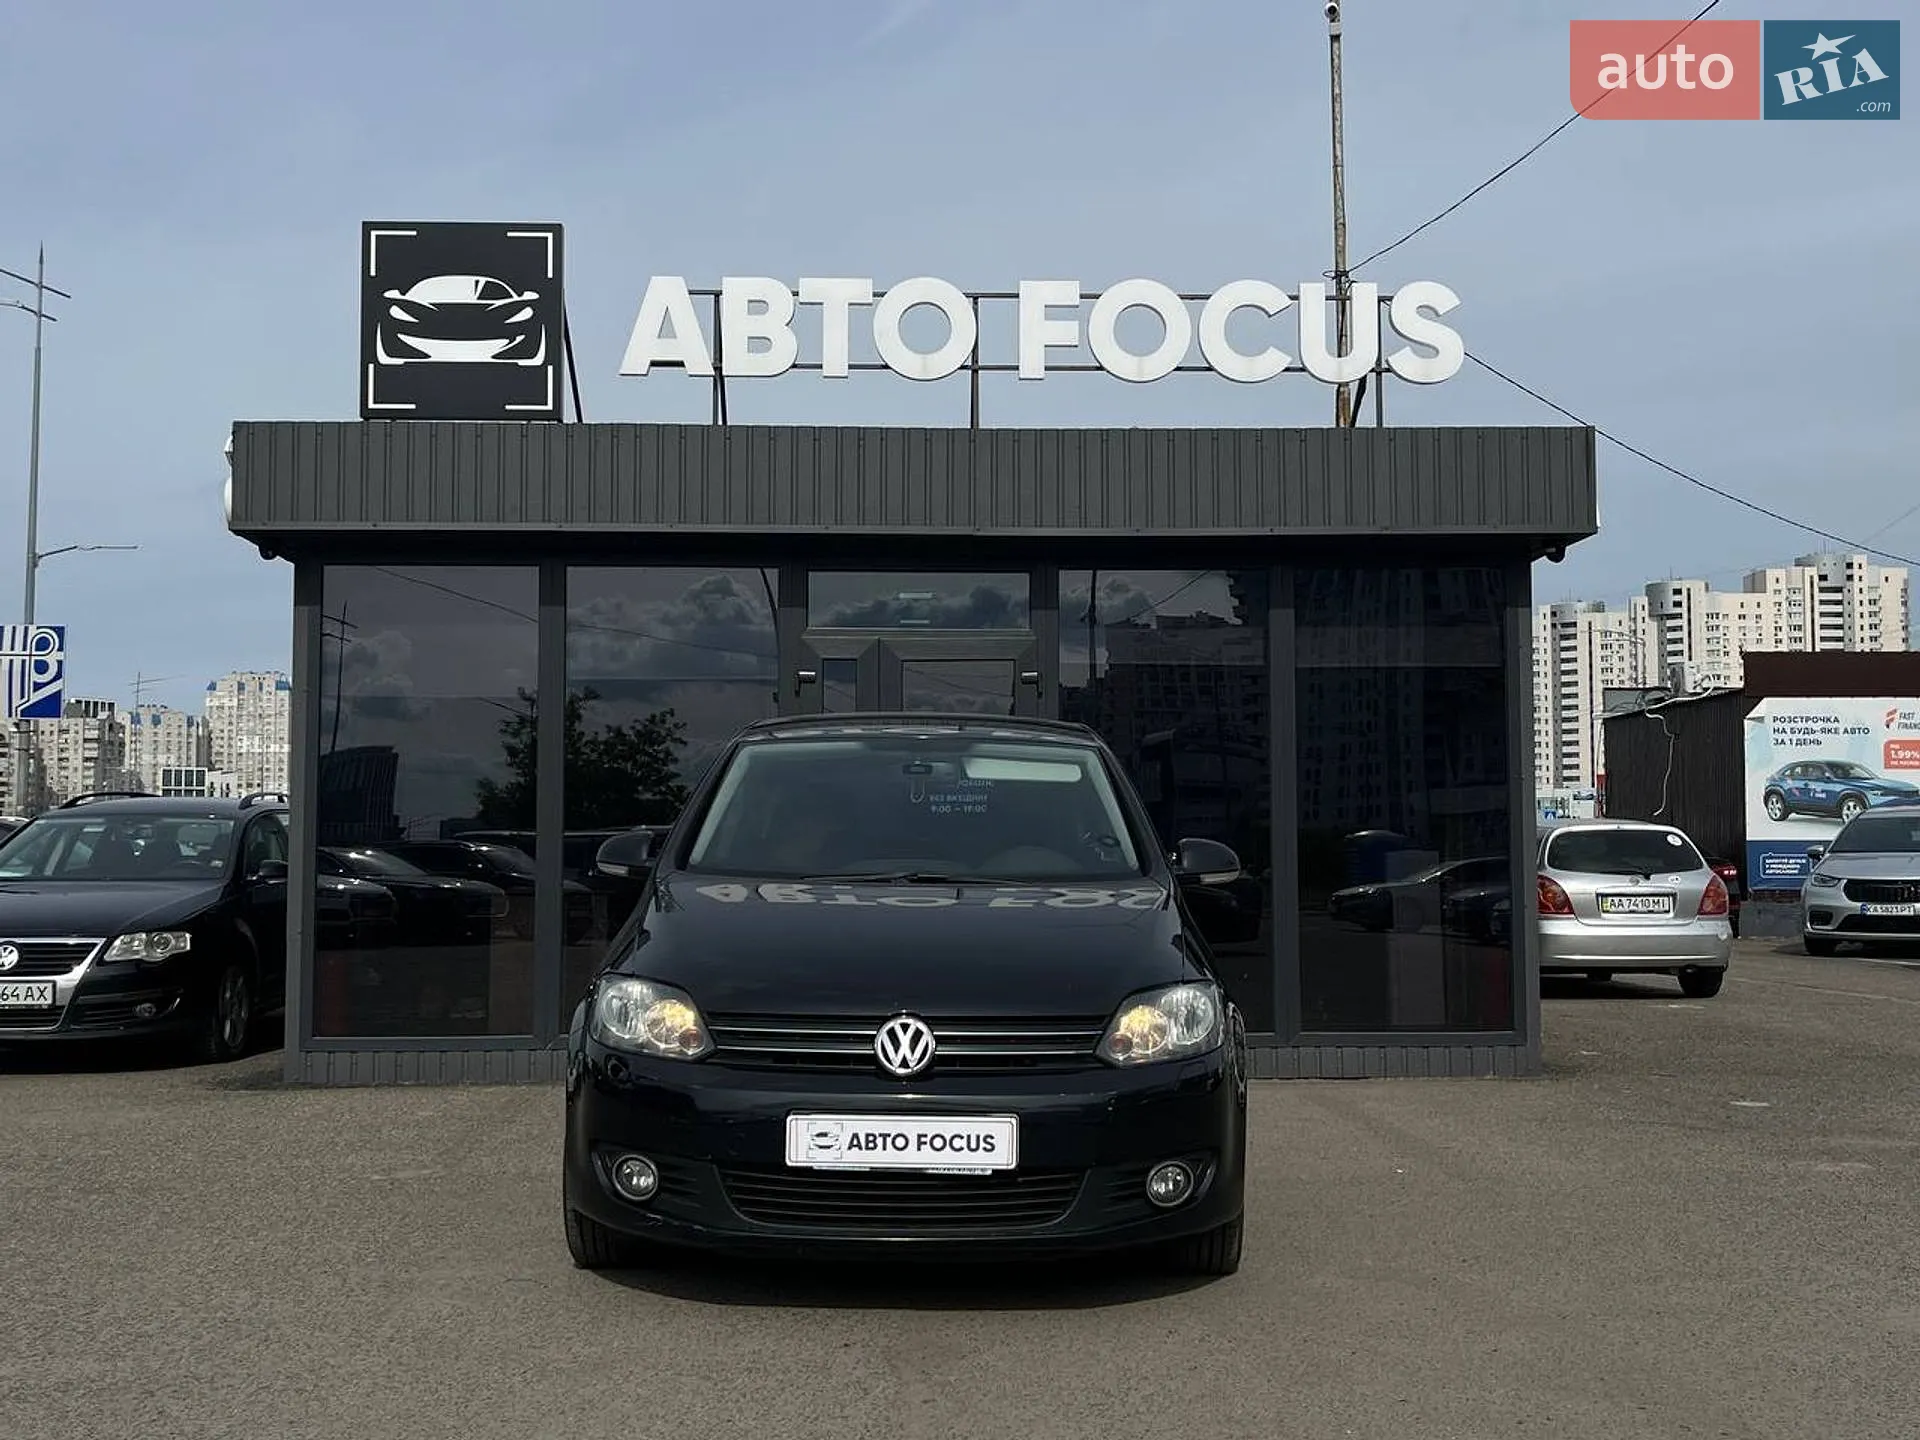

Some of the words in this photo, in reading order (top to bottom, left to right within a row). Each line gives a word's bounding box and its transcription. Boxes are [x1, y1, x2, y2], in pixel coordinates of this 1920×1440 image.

[618, 275, 978, 382] АВТО
[1018, 278, 1465, 385] FOCUS
[1772, 715, 1840, 724] РОЗСТРОЧКА
[1772, 726, 1787, 735] НА
[1789, 726, 1840, 736] БУДЬ-ЯКЕ
[1842, 726, 1871, 735] АВТО
[1772, 737, 1786, 746] ЗА
[1788, 737, 1793, 746] 1
[1794, 737, 1822, 747] ДЕНЬ
[847, 1132, 910, 1152] АВТО
[916, 1133, 996, 1153] FOCUS
